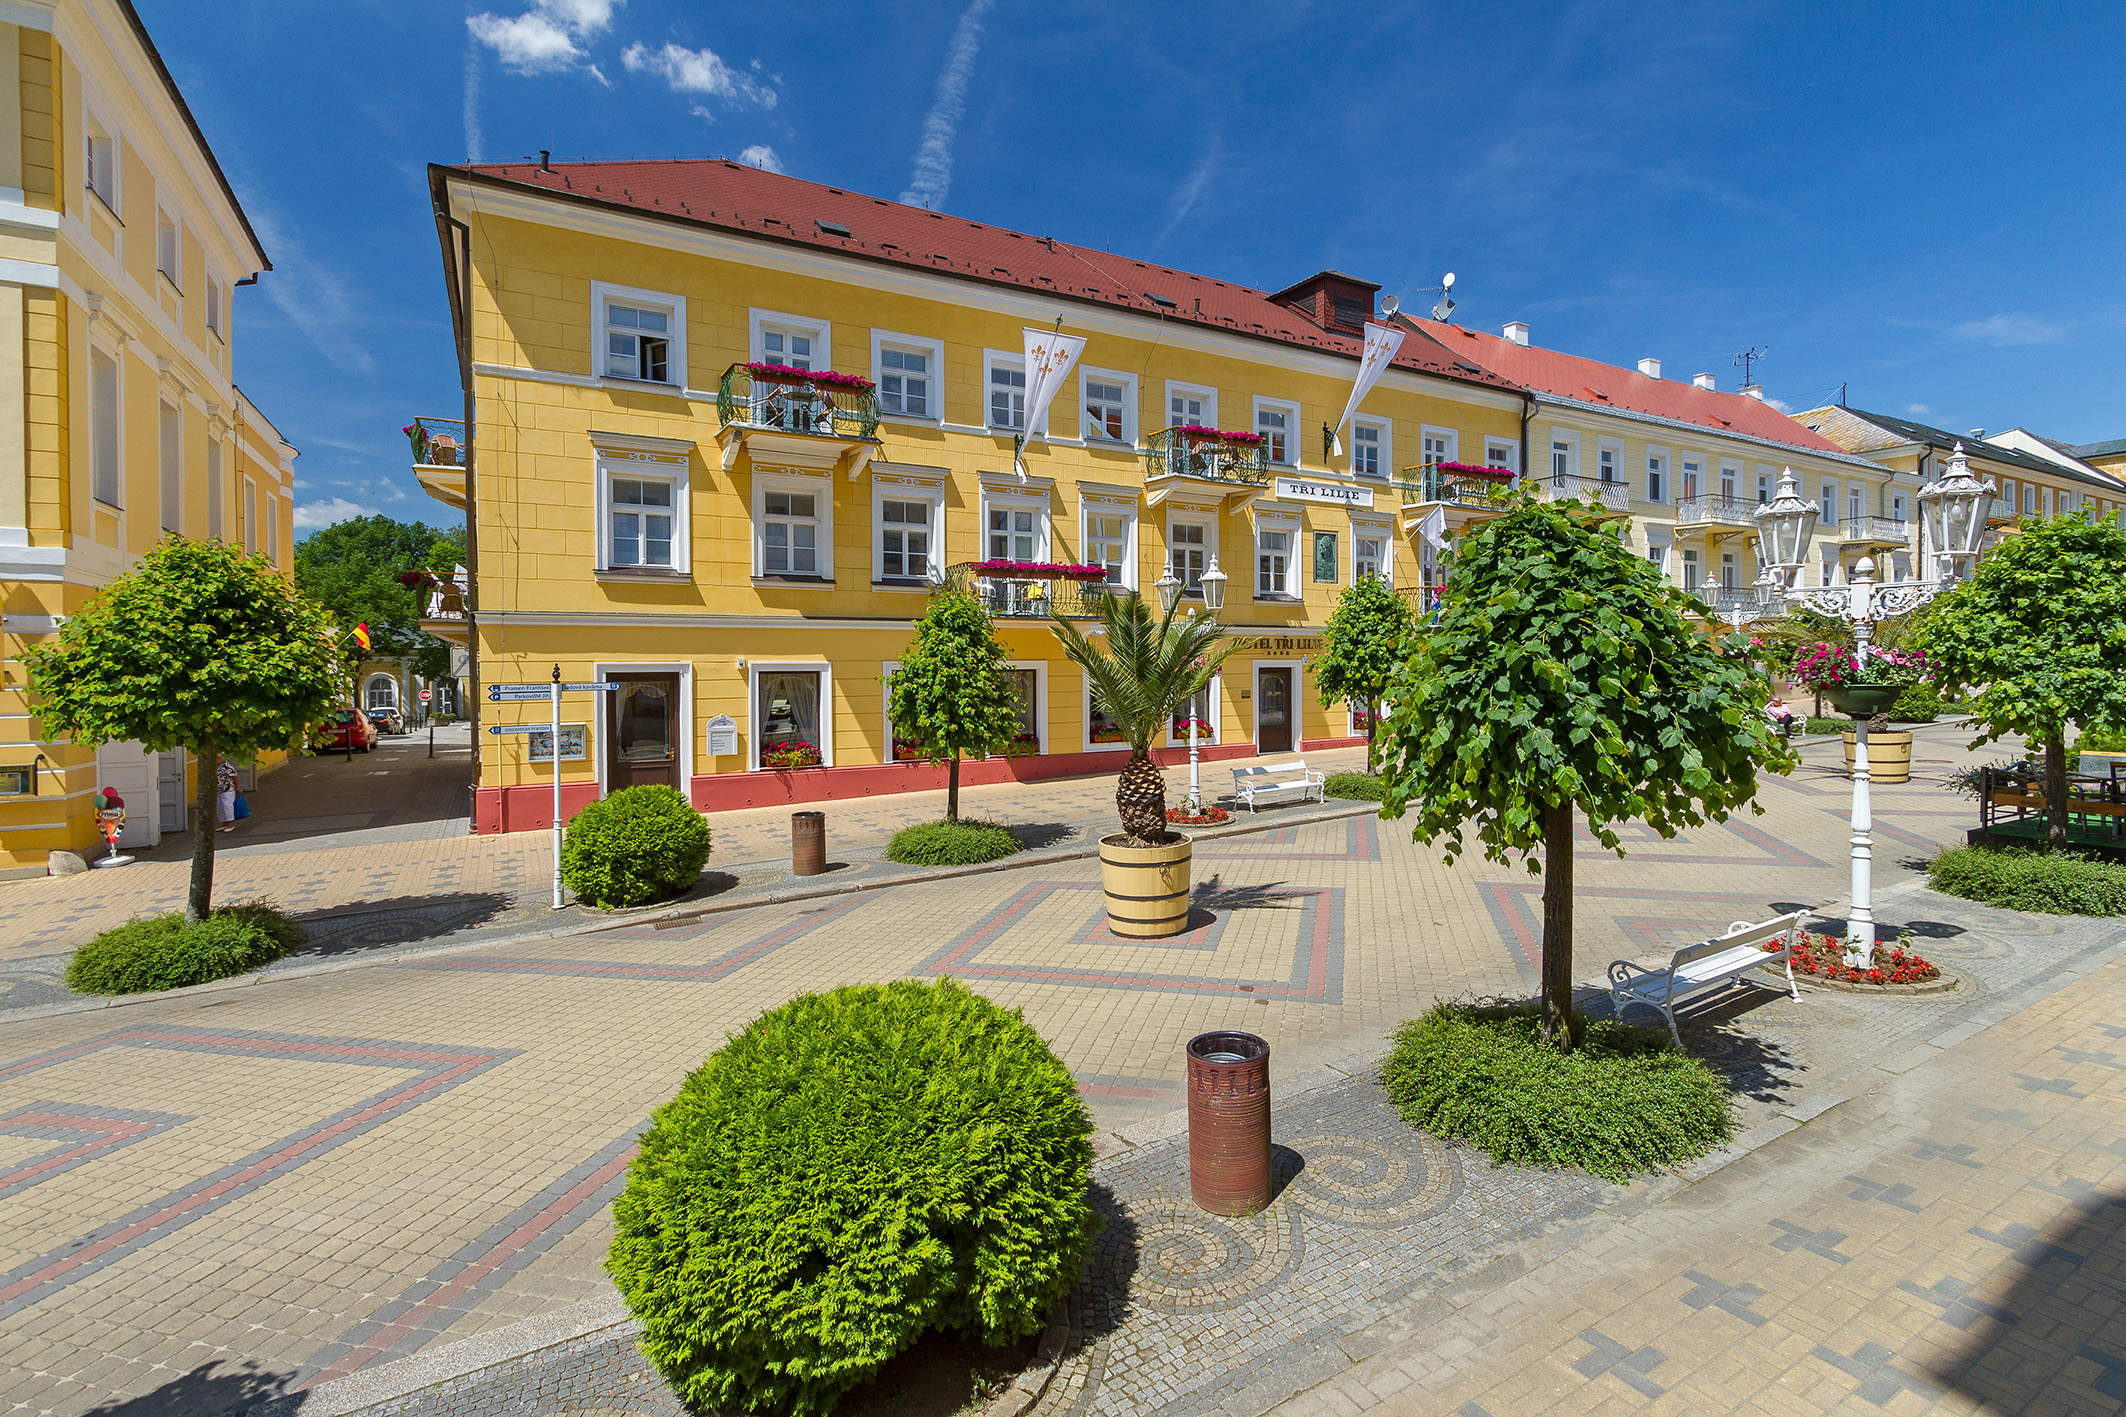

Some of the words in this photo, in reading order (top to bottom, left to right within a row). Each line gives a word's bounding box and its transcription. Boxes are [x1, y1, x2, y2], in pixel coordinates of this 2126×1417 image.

[1290, 484, 1315, 495] TŘI
[1321, 488, 1360, 500] LILIE
[1274, 635, 1294, 650] TŘI
[1296, 638, 1324, 650] LILIE
